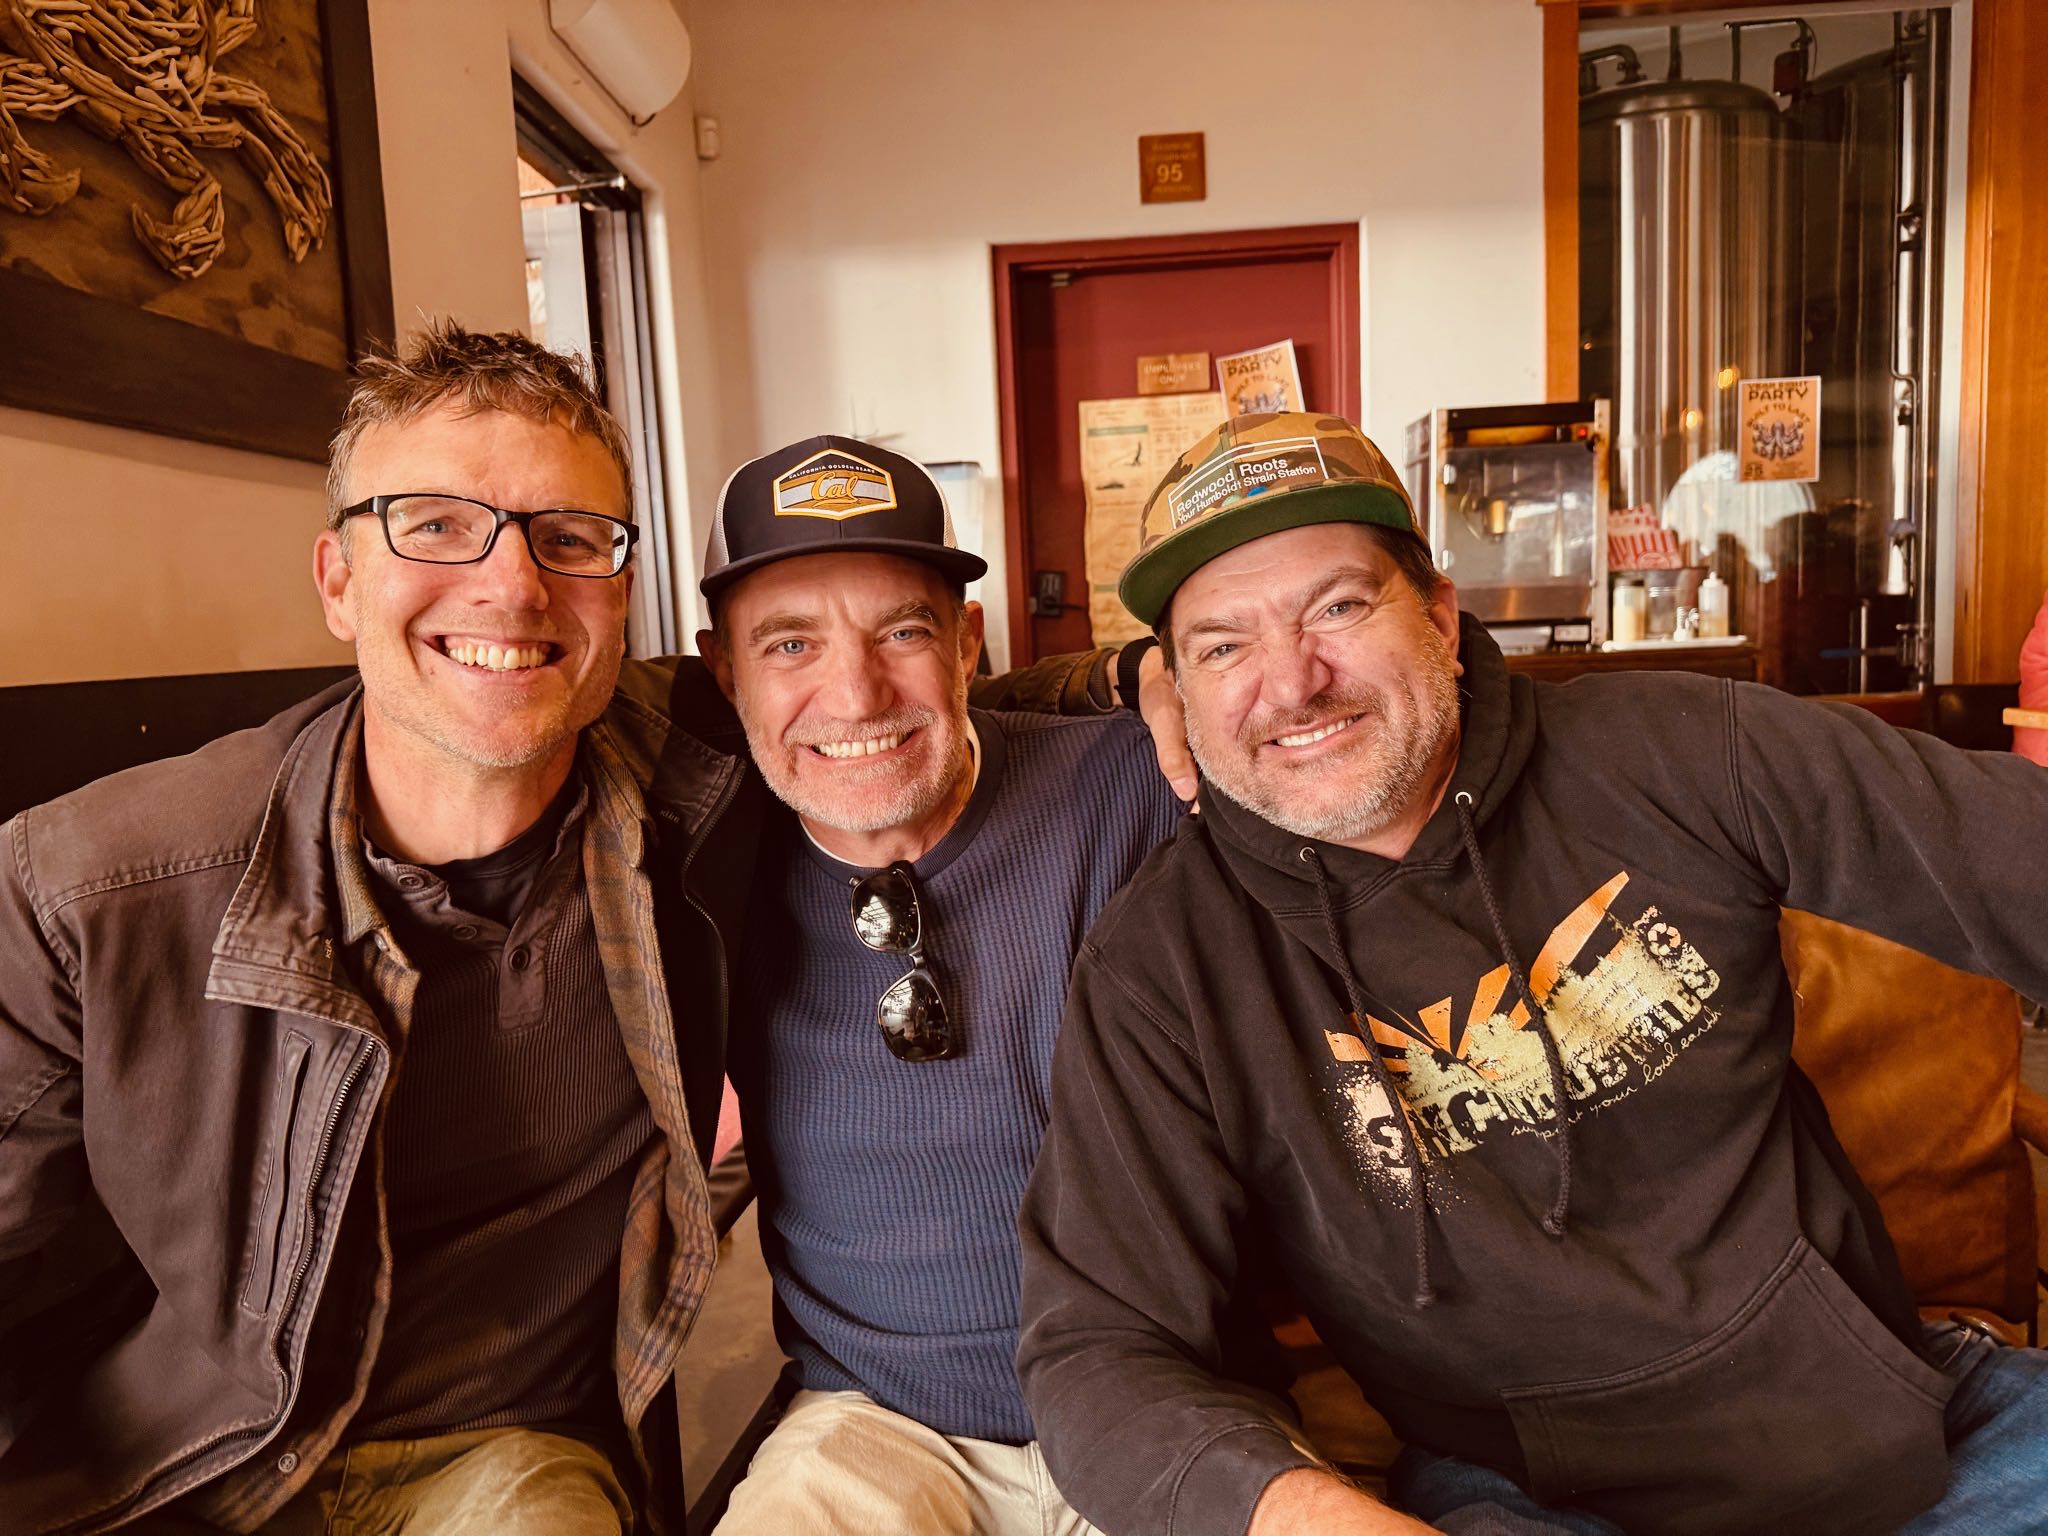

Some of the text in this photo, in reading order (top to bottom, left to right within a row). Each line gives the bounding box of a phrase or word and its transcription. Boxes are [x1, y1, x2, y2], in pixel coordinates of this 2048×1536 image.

[1157, 163, 1183, 183] 95
[1228, 353, 1282, 377] PARTY
[1748, 386, 1808, 402] PARTY
[789, 465, 826, 479] CALIFORNIA
[855, 466, 876, 474] BEARS
[811, 471, 859, 508] Cal
[1176, 457, 1288, 514] Redwood Roots
[1178, 466, 1316, 525] Your Humboldt Strain Station
[1438, 1070, 1472, 1093] earth
[1590, 1086, 1638, 1116] your
[1643, 1041, 1679, 1086] local
